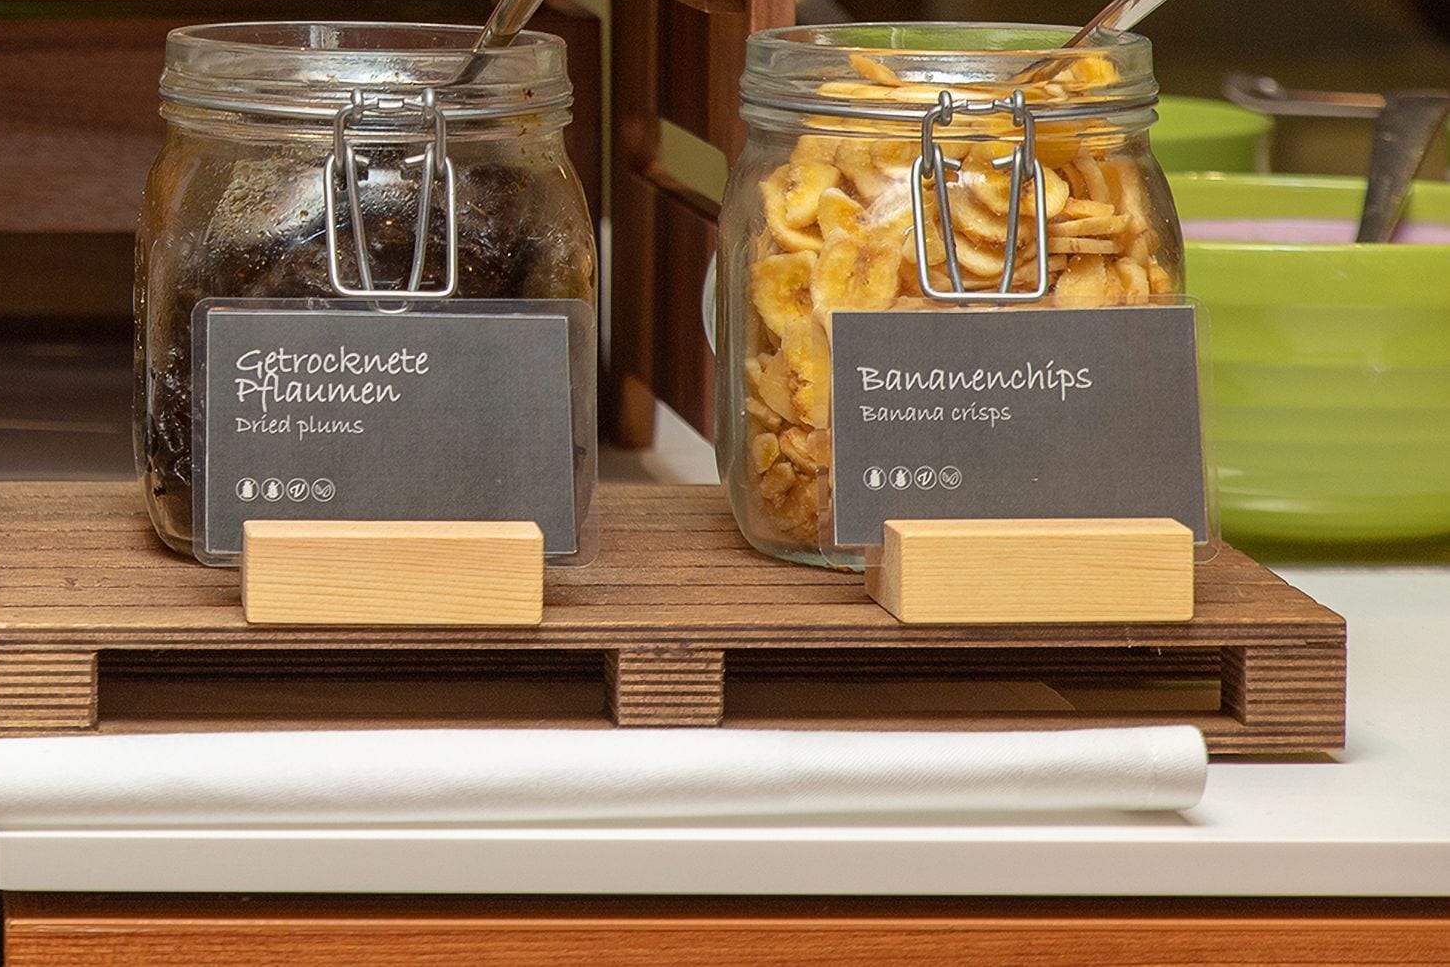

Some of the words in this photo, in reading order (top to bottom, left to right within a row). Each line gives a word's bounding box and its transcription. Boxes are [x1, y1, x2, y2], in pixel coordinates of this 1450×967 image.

[235, 346, 430, 376] Getrocknete
[235, 373, 400, 412] Pflaumen
[856, 360, 1093, 401] Bananenchips
[235, 414, 291, 434] Dried
[296, 416, 364, 440] plums
[859, 404, 944, 422] Banana
[951, 402, 1012, 427] crisps
